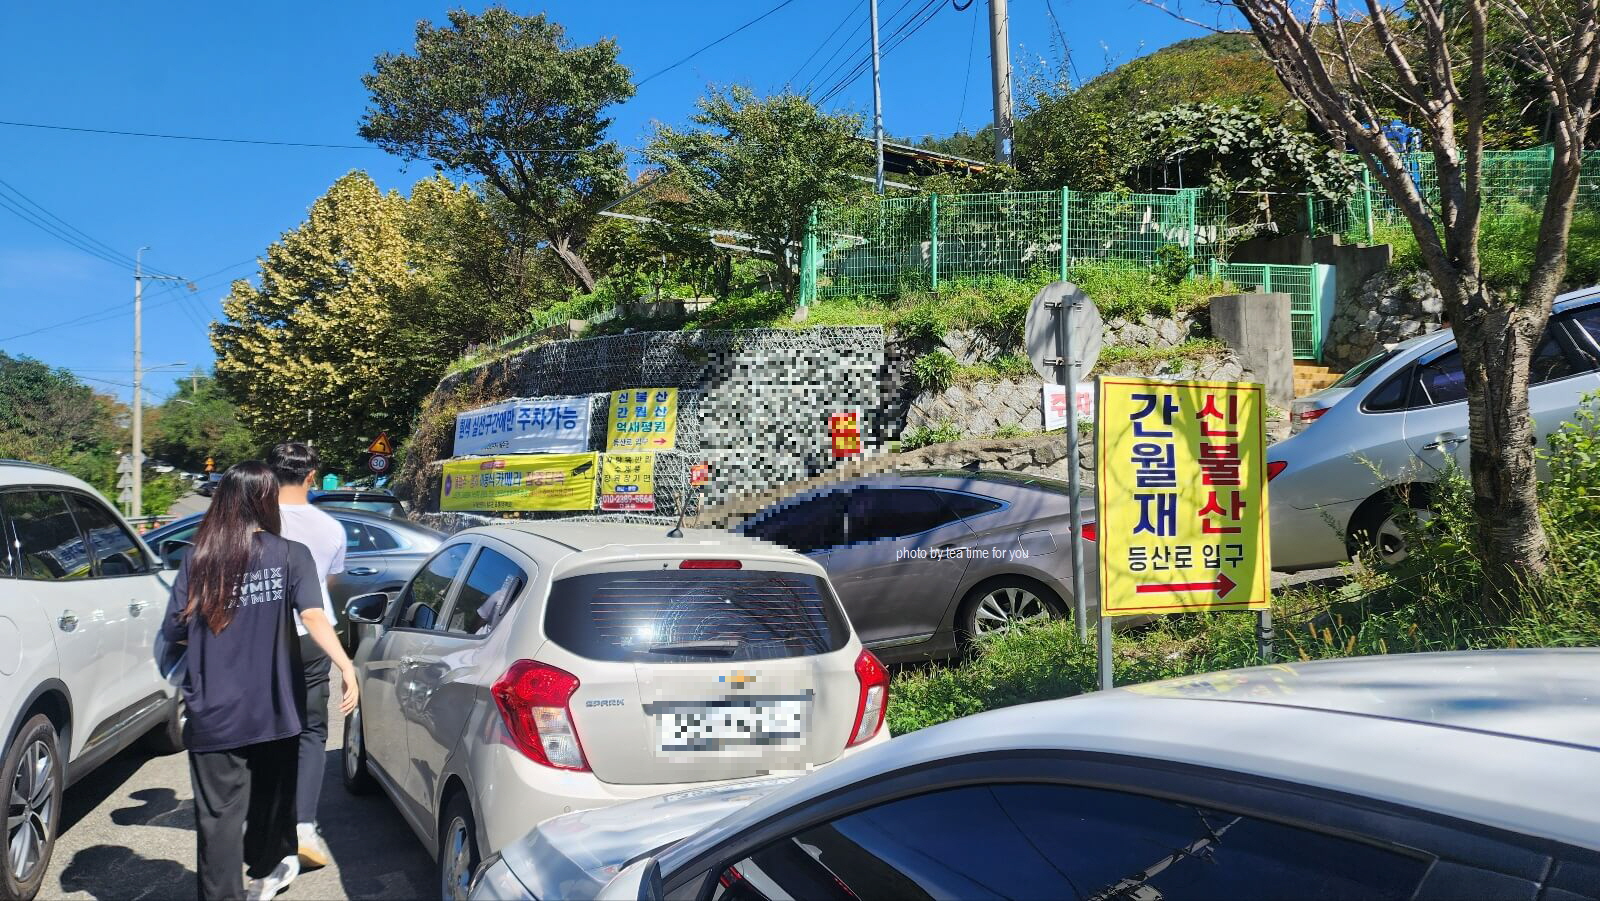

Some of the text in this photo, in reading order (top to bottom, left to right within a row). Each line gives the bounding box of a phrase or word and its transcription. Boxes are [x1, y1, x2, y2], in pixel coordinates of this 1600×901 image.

[516, 406, 578, 431] 주차가능
[616, 421, 666, 433] 억새평원
[372, 458, 385, 468] 30
[1129, 393, 1179, 537] 간월재
[1195, 394, 1246, 534] 신불산
[1128, 544, 1244, 572] 등산로 입구
[585, 698, 625, 707] SPARK
